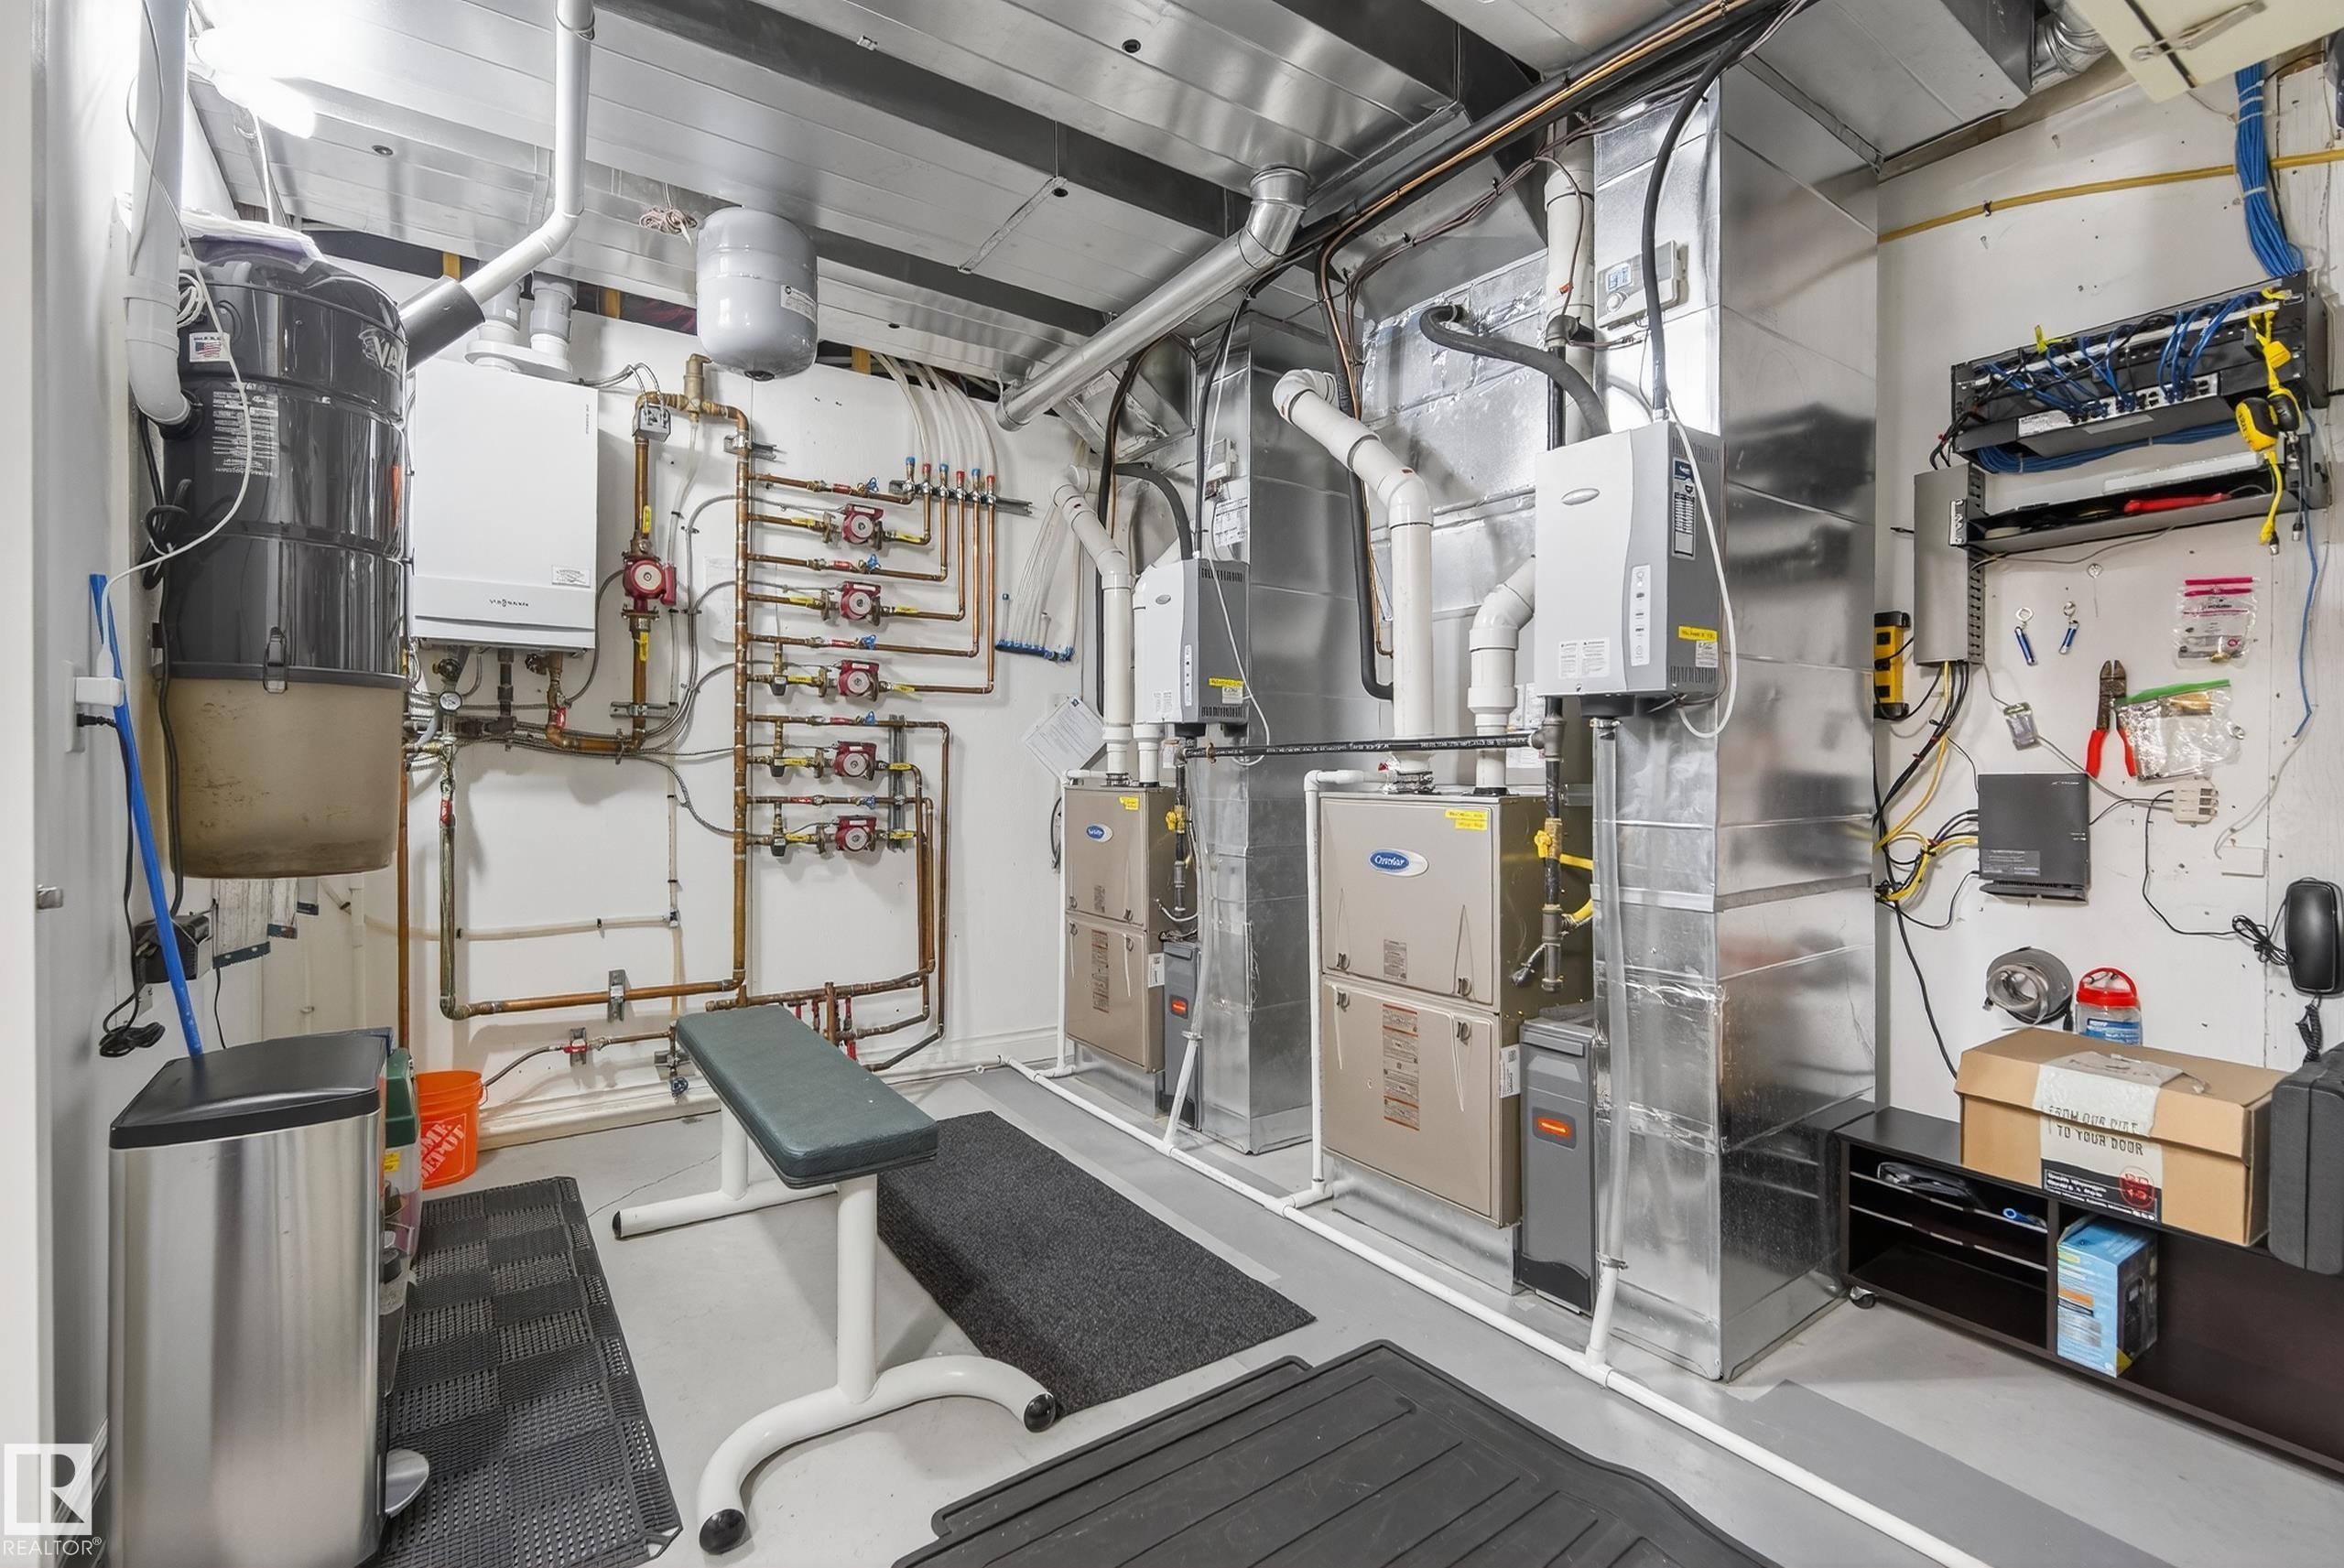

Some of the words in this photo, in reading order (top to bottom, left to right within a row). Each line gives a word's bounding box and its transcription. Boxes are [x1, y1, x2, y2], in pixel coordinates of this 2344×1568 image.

[421, 1123, 451, 1152] OME
[2056, 1123, 2071, 1139] TO
[2075, 1129, 2107, 1147] YOUR
[2111, 1137, 2143, 1155] DOOR
